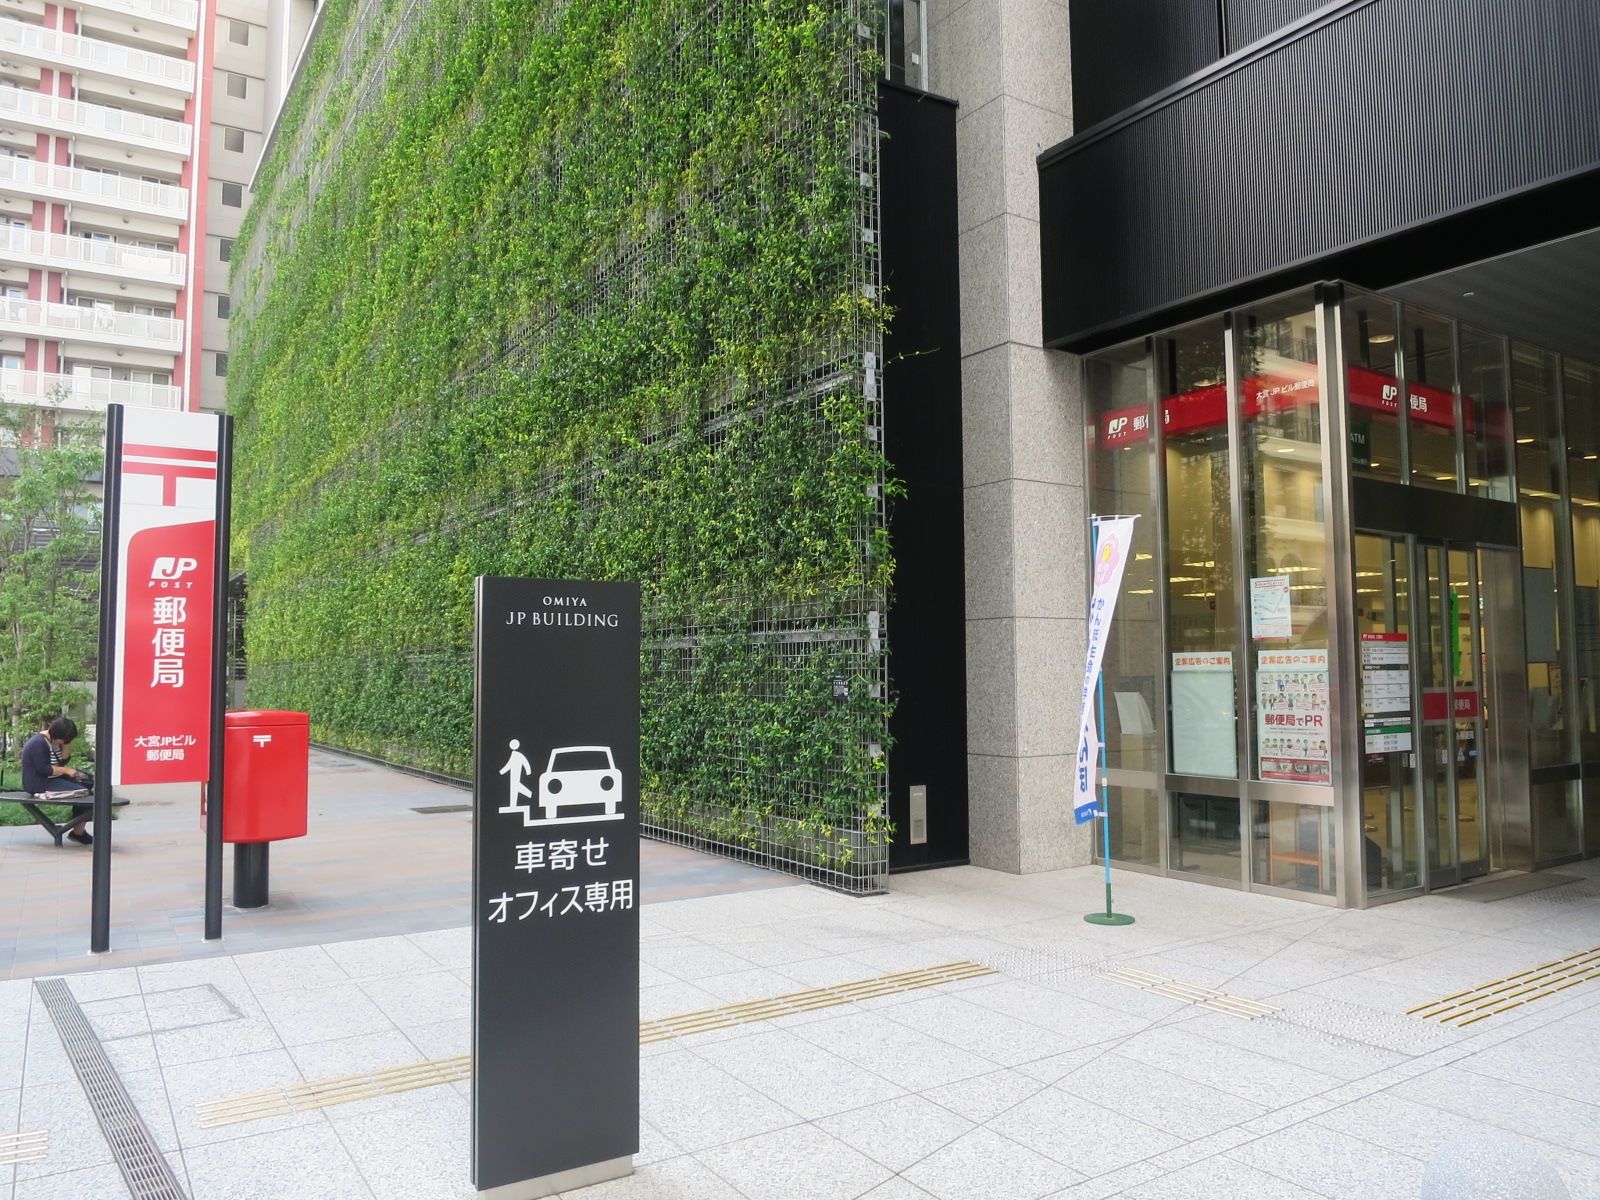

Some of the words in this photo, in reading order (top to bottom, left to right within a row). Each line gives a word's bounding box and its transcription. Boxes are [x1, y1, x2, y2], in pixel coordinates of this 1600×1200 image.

[1107, 432, 1127, 440] POST
[1350, 433, 1365, 444] ATM
[148, 580, 192, 589] POST
[542, 597, 587, 607] OMIYA
[506, 612, 527, 626] JP
[532, 612, 619, 628] BUILDING
[151, 596, 187, 688] 郵便局
[1265, 713, 1323, 727] 郵便局でPR
[134, 734, 196, 748] 大宮JPビル
[145, 748, 184, 761] 郵便局
[514, 836, 609, 874] 車寄せ
[488, 879, 633, 923] オフィス専用
